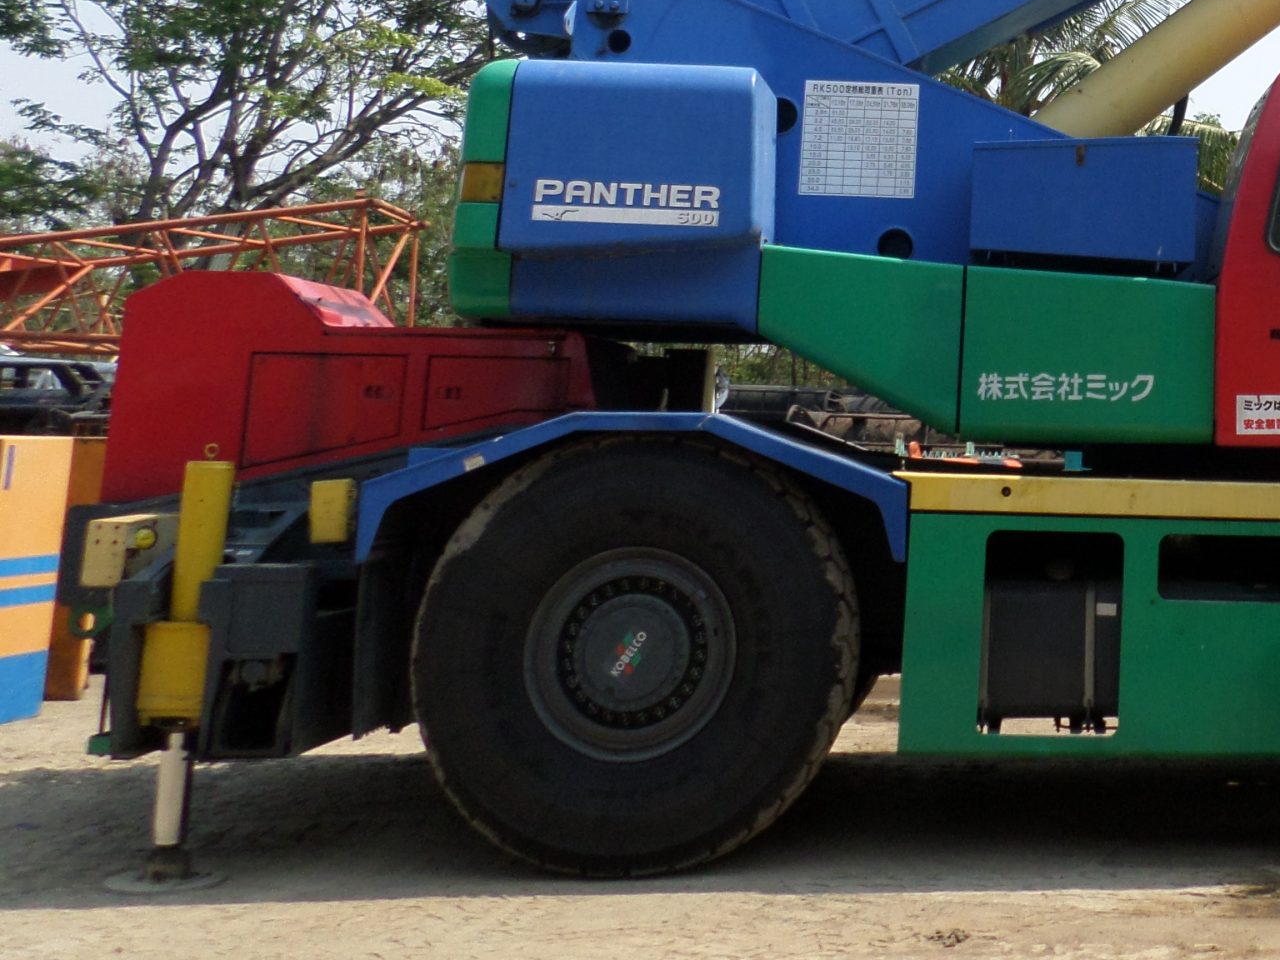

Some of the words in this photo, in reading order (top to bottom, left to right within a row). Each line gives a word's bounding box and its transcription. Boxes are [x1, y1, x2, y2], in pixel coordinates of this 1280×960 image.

[534, 179, 721, 209] PANTHER
[977, 373, 1154, 402] 株式会社ミック
[610, 631, 647, 677] KOBELCO
